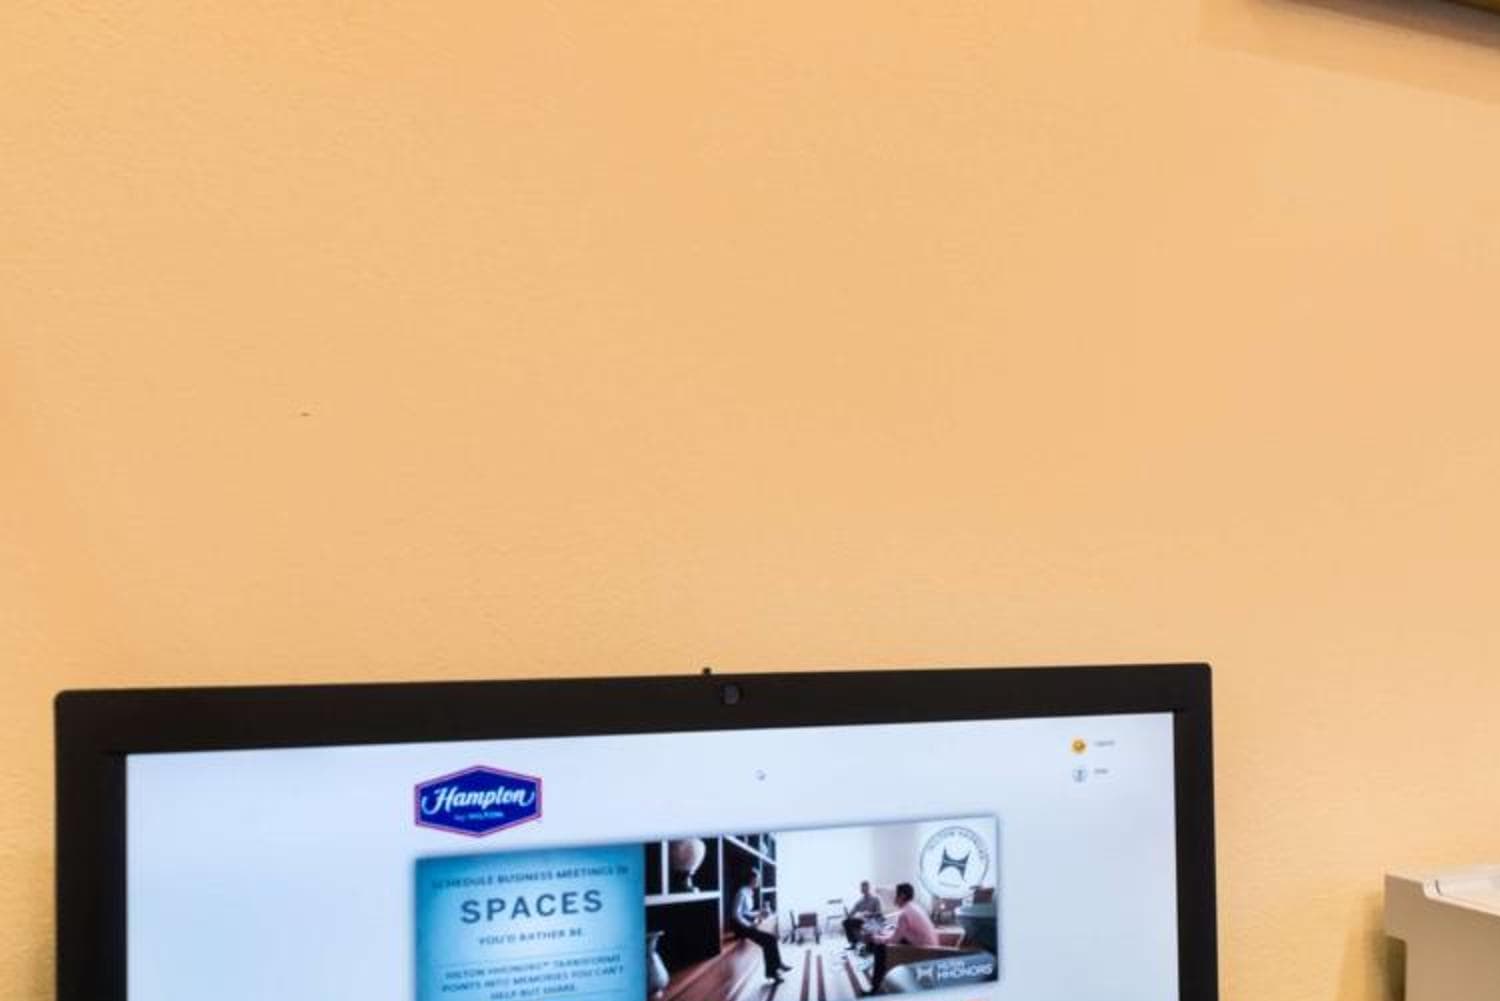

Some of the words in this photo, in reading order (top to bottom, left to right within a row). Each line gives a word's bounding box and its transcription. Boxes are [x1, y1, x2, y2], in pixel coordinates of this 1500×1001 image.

[421, 785, 536, 816] Hampton
[497, 871, 553, 884] BUSINESS
[556, 866, 613, 879] MEETINGS
[460, 889, 603, 924] SPACES
